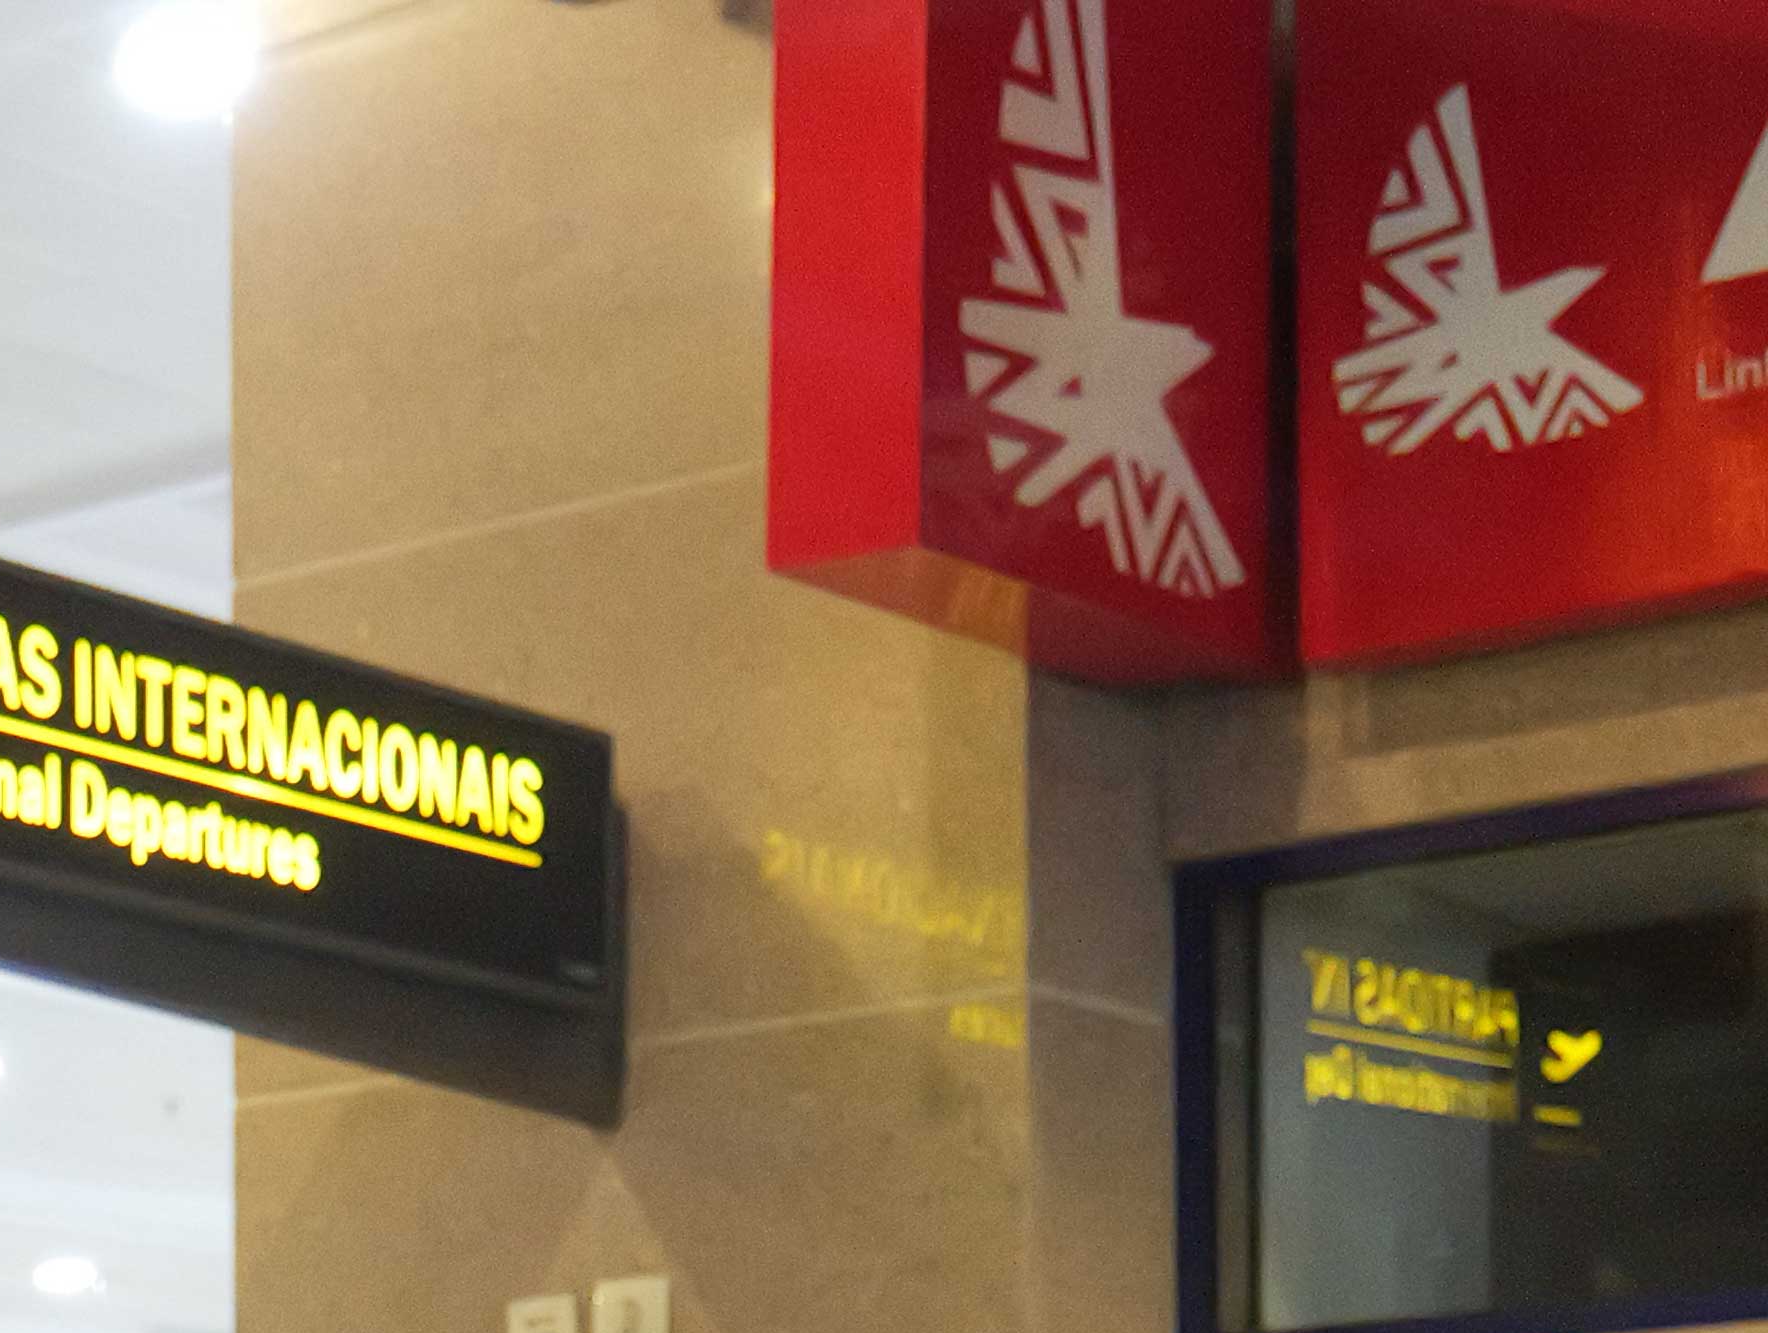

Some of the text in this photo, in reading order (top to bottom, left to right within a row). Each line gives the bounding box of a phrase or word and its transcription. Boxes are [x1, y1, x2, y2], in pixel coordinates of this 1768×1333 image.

[1696, 345, 1768, 400] Lin
[73, 636, 545, 846] INTERNACIONAIS
[69, 757, 322, 892] Departures
